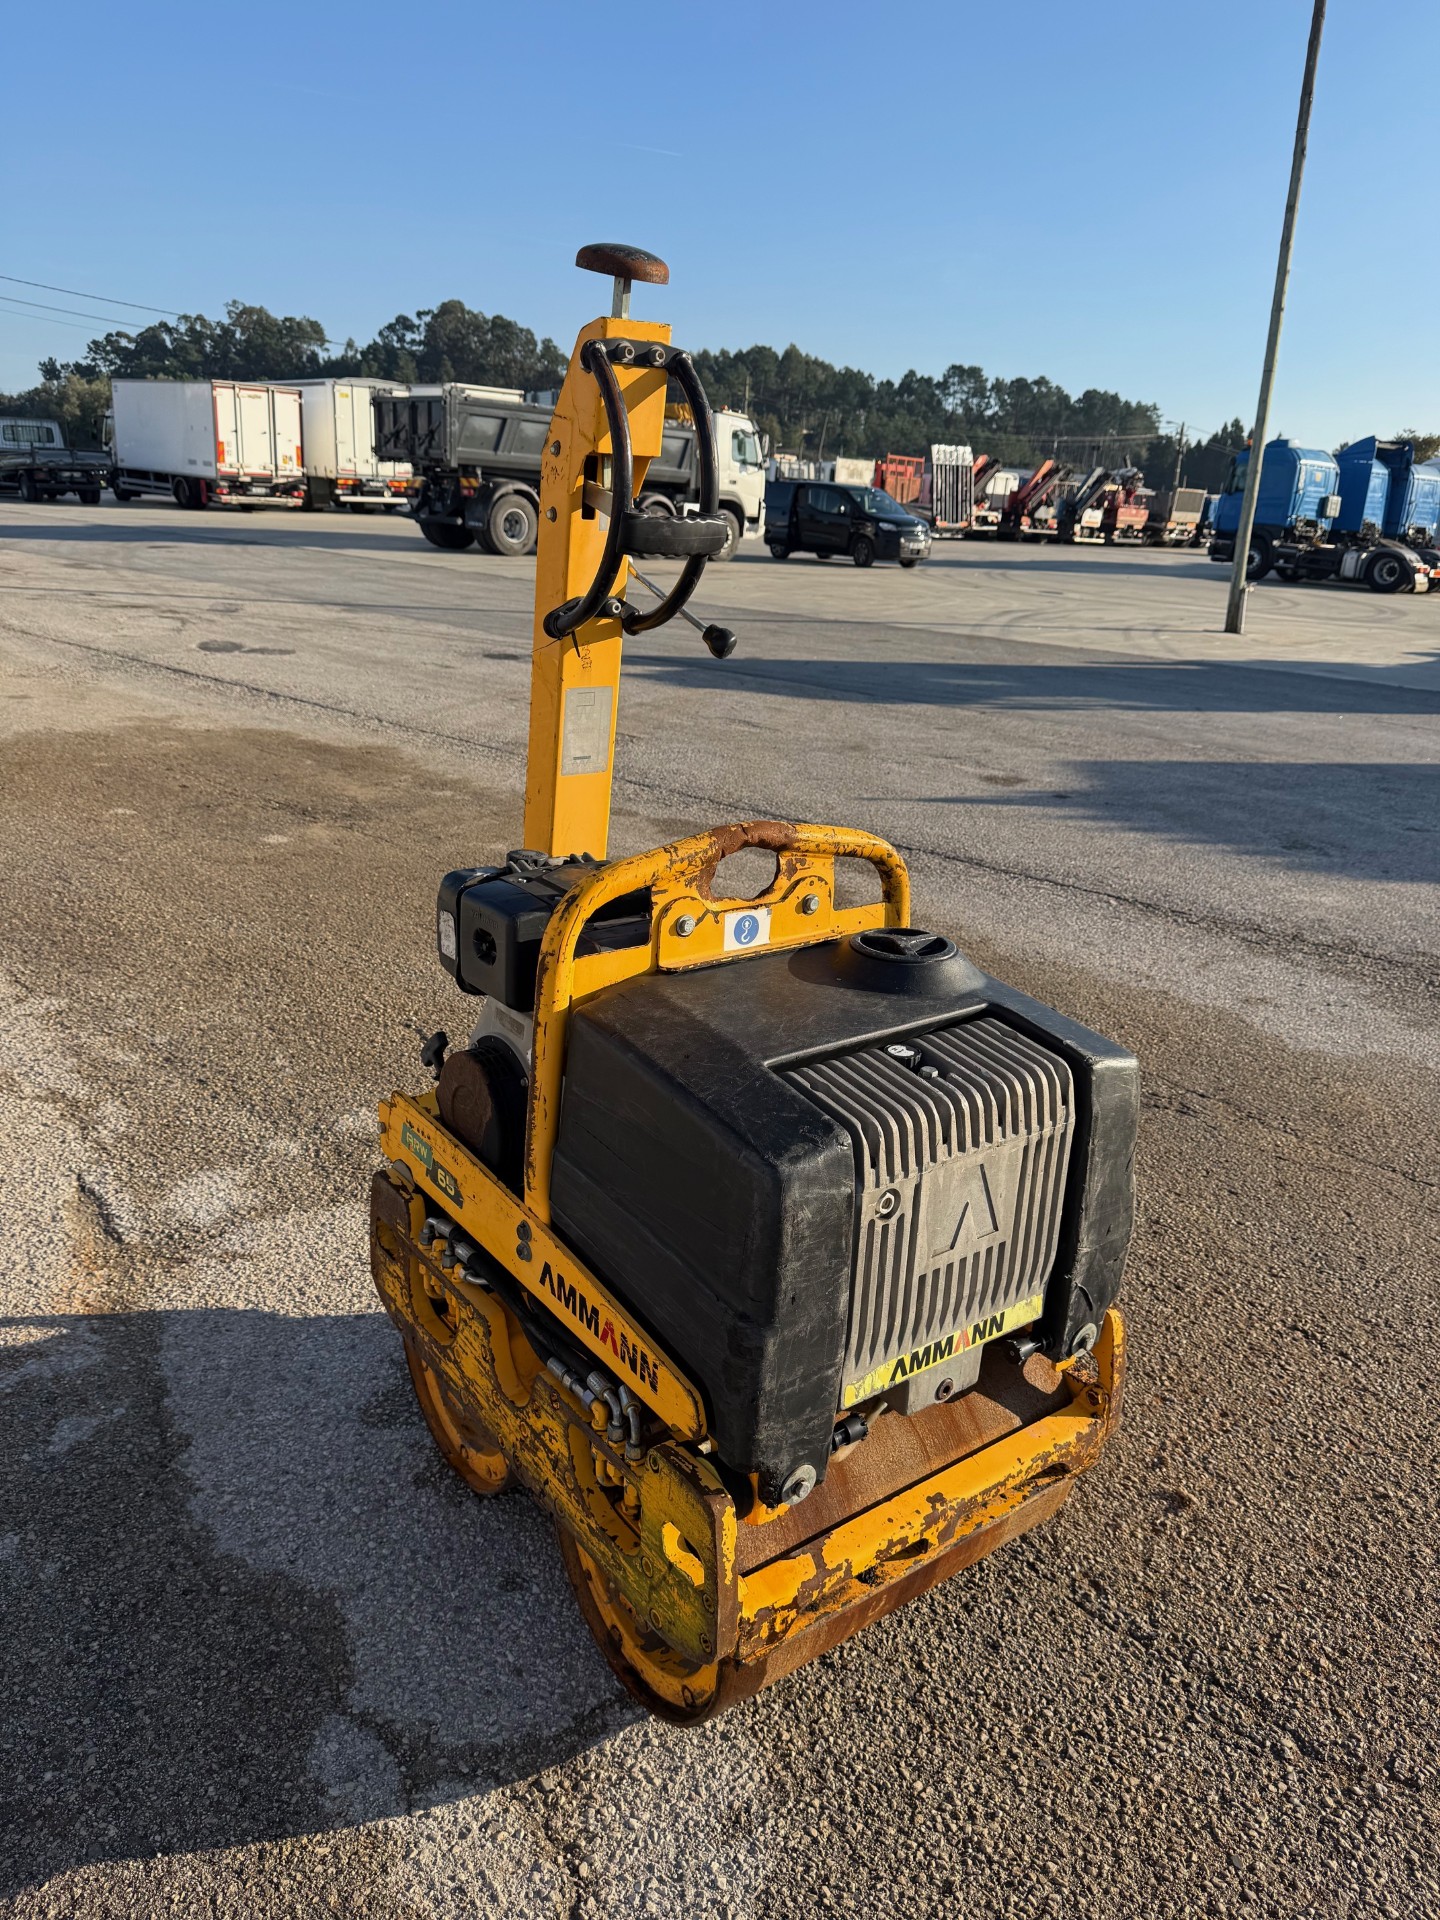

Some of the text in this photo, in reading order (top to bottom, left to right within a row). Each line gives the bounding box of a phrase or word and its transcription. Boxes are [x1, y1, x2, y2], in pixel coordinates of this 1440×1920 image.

[437, 1168, 455, 1195] 65
[539, 1262, 660, 1395] AMMANN
[889, 1312, 1006, 1382] AMMANN
